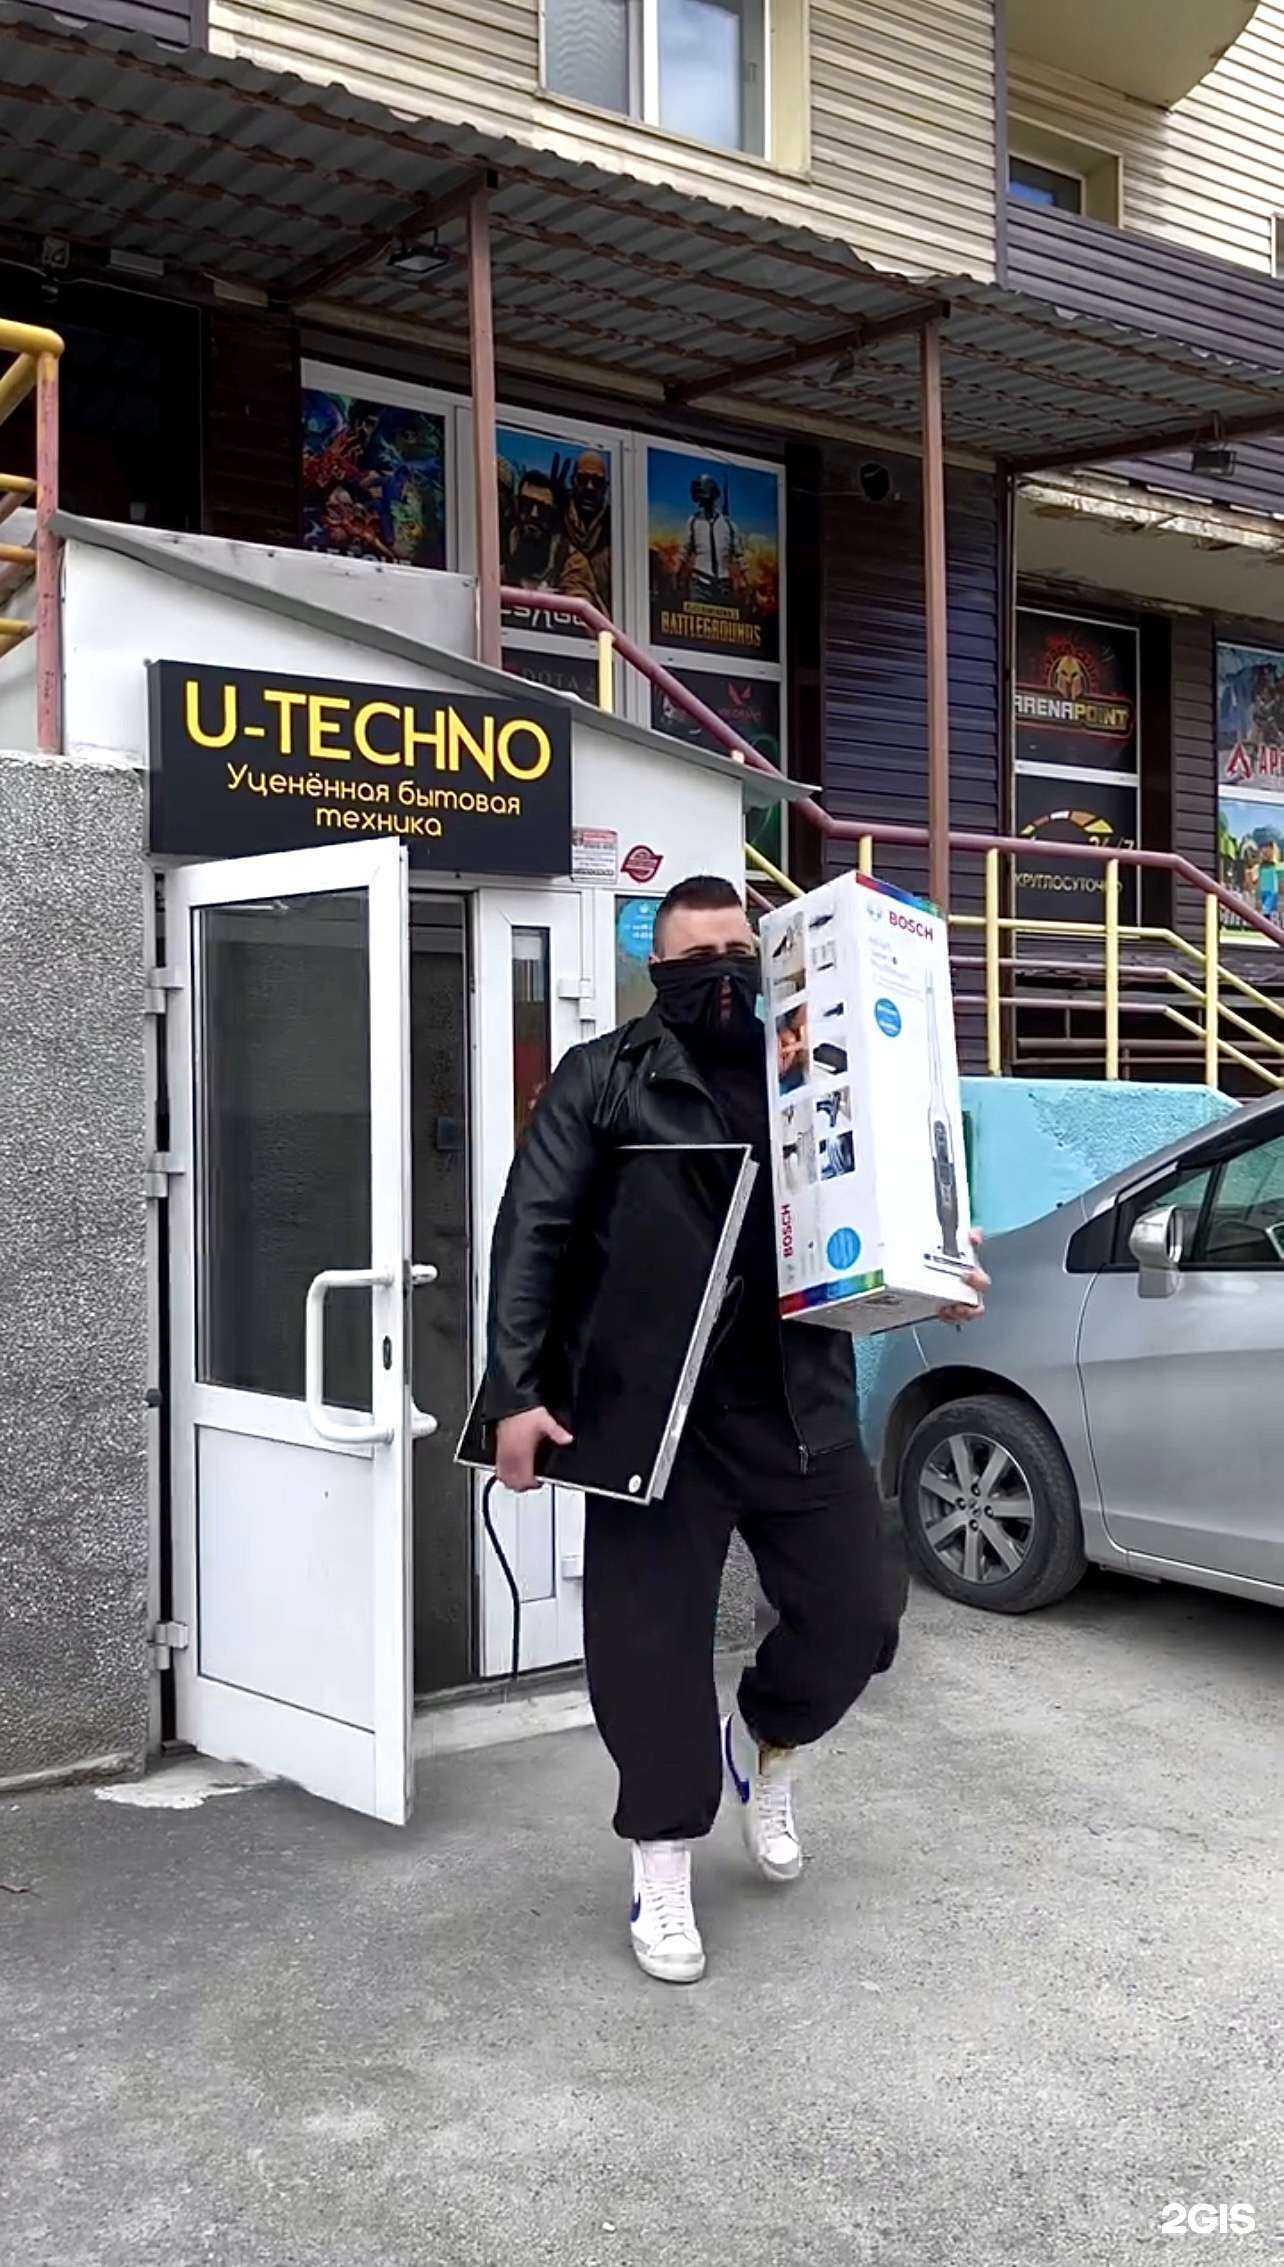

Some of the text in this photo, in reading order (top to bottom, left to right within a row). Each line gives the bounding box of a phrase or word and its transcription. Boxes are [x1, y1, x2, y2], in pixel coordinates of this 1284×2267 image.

[661, 610, 762, 649] BATTLEGROUNDS
[186, 681, 552, 782] U-TECHNO
[227, 763, 521, 816] Уценённая бытовая
[316, 807, 443, 837] техника
[889, 910, 934, 942] BOSCH
[781, 1203, 793, 1258] BOSCH
